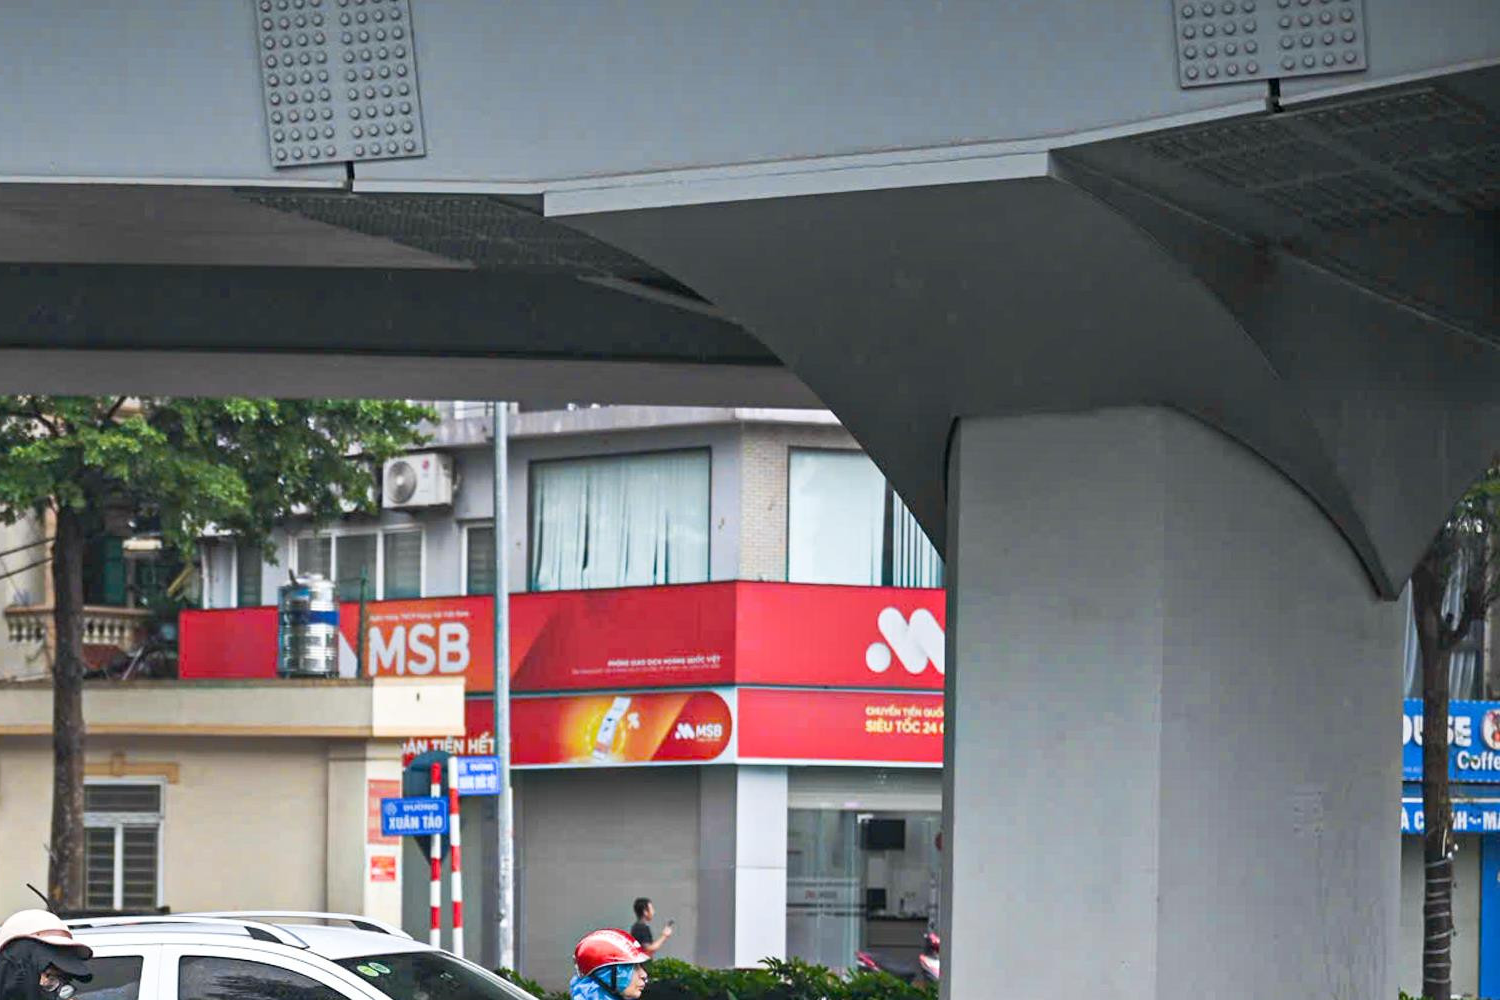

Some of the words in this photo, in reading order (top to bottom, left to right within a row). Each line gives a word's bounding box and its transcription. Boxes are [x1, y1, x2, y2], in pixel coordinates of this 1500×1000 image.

[368, 621, 471, 677] MSB
[695, 723, 723, 737] MSB
[922, 721, 938, 734] 24
